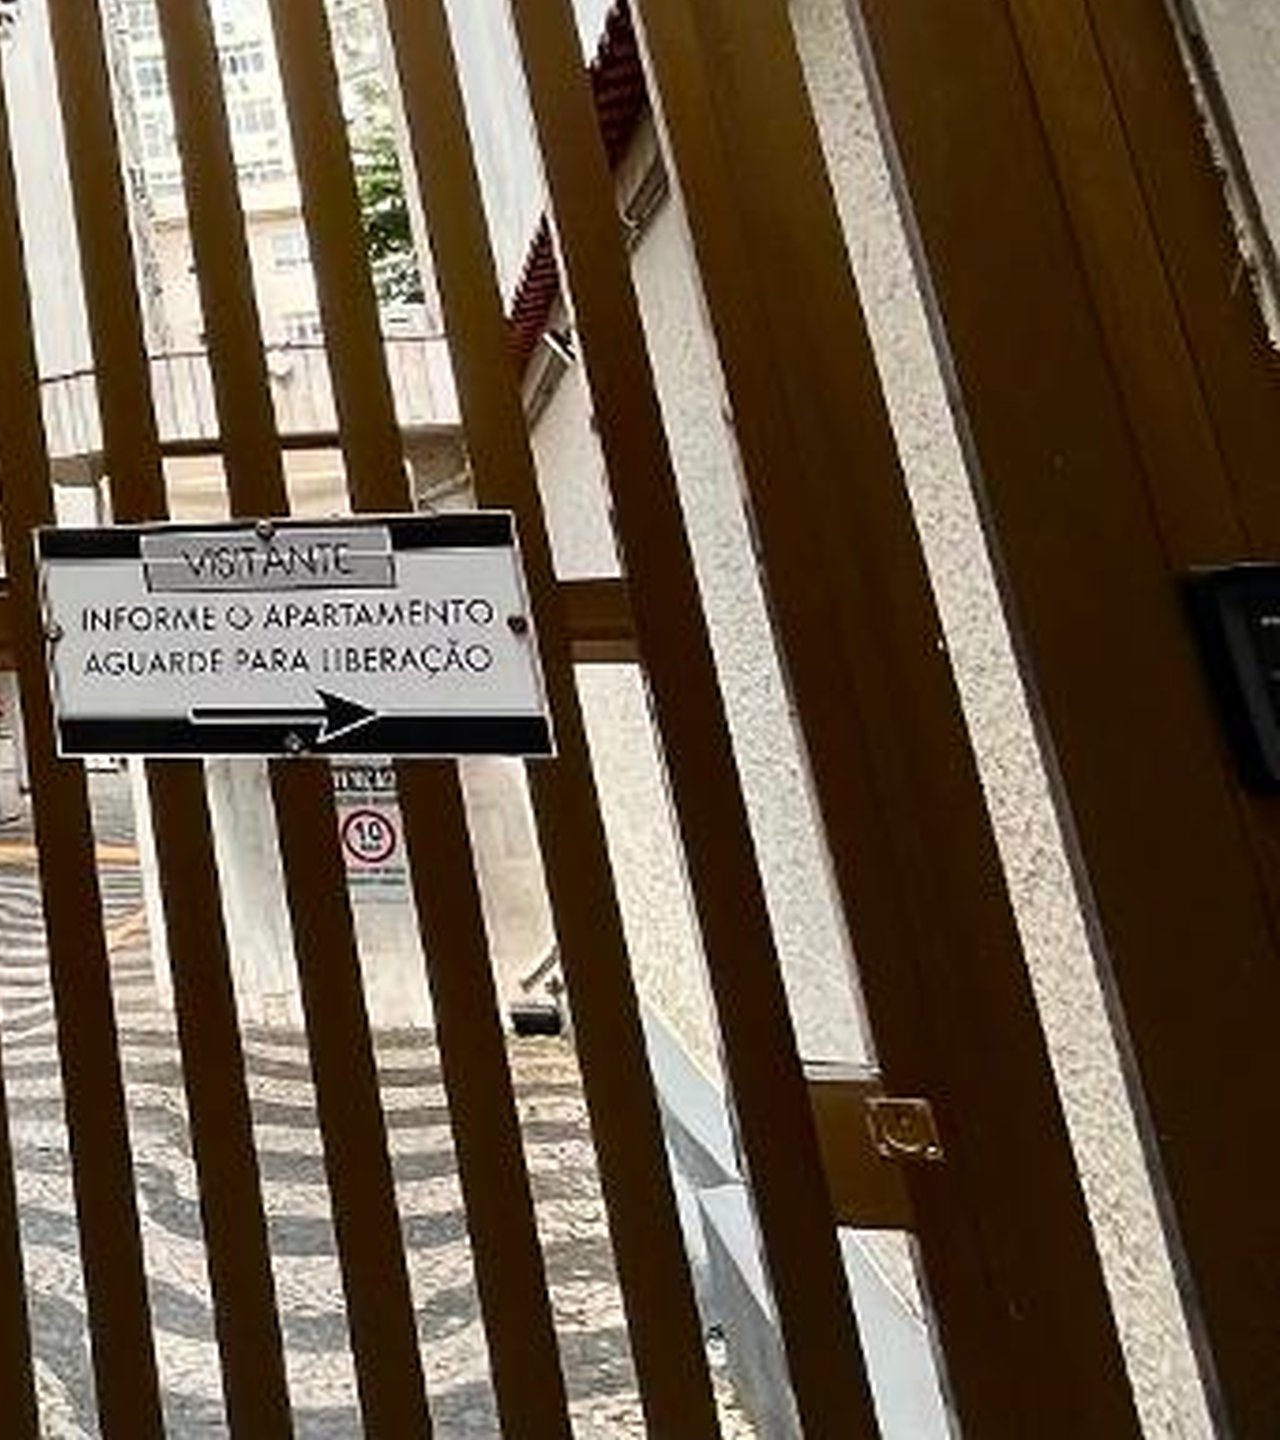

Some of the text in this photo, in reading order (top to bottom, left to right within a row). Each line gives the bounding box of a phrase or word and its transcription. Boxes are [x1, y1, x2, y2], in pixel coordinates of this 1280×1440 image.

[181, 542, 354, 580] VISITANTE
[82, 598, 493, 632] INFORME O APARTAMENTO
[84, 650, 222, 677] AGUARDE
[237, 646, 310, 672] PARA
